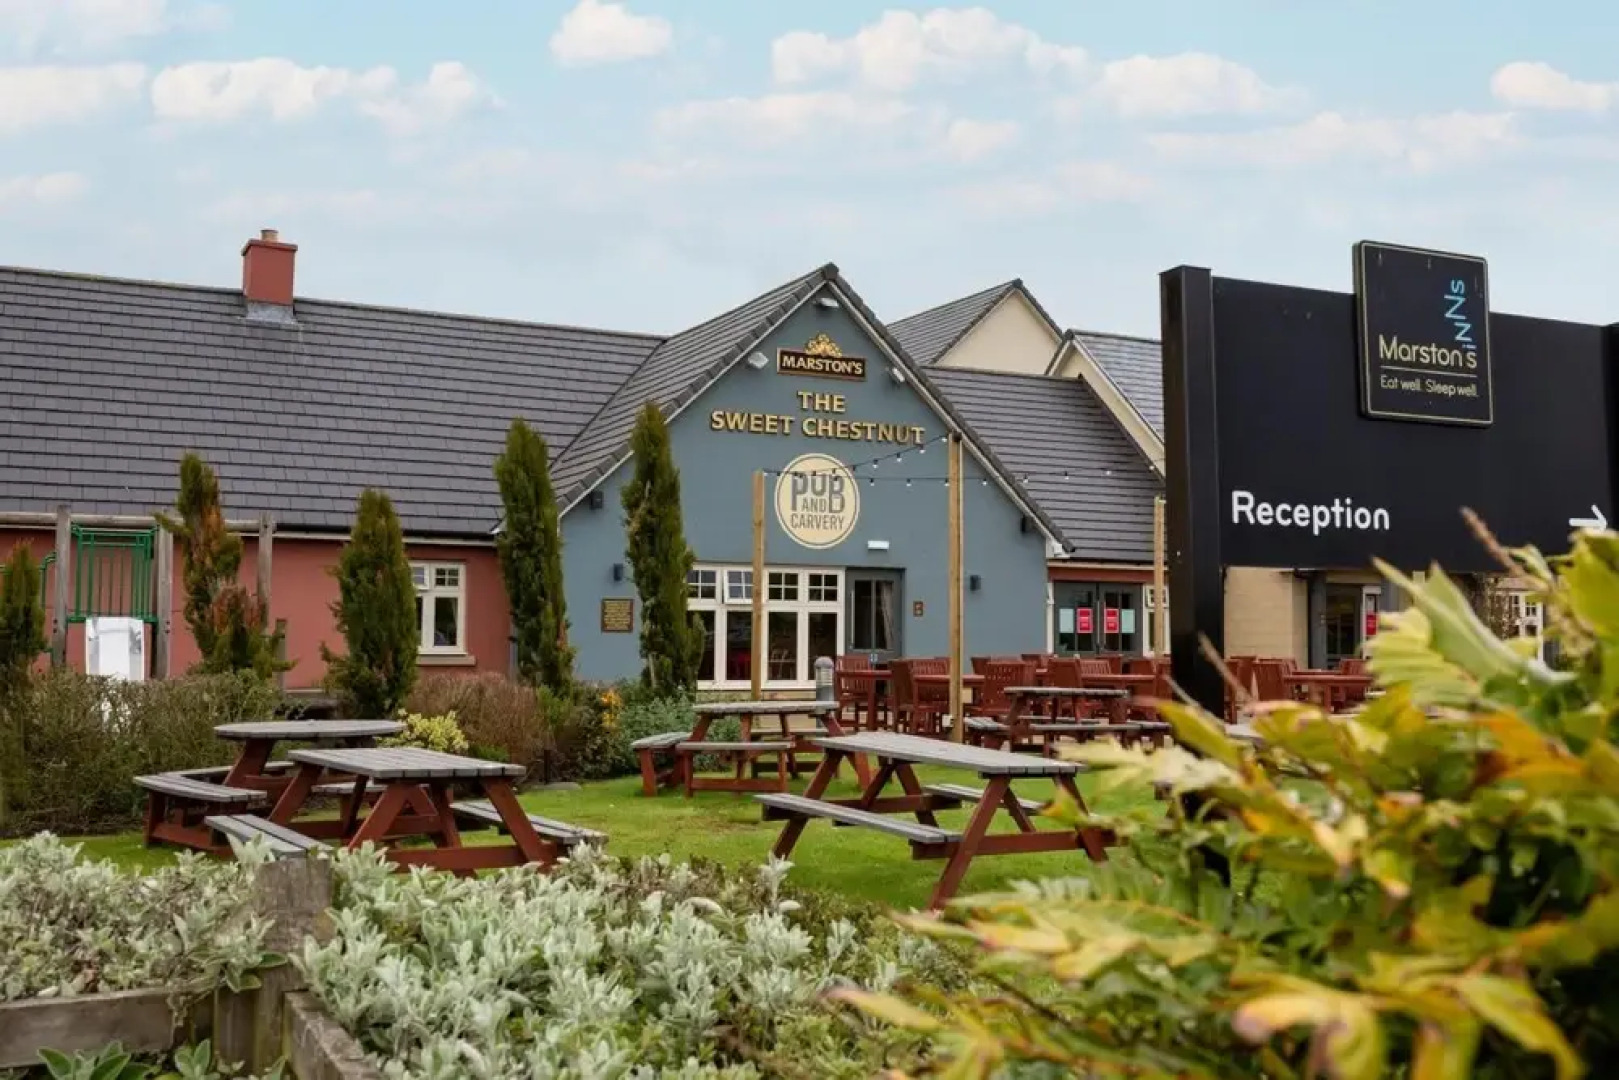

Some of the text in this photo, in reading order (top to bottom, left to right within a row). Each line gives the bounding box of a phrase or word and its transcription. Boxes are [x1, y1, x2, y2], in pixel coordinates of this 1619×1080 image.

[782, 355, 863, 375] MARSTON'S
[1380, 374, 1398, 389] Eat
[1425, 379, 1456, 397] Sleep
[797, 391, 846, 413] THE
[711, 410, 926, 444] SWEET CHESTNUT
[791, 473, 845, 513] PUB
[802, 499, 826, 513] AND
[1231, 490, 1390, 535] Reception
[791, 513, 845, 530] CARVERY
